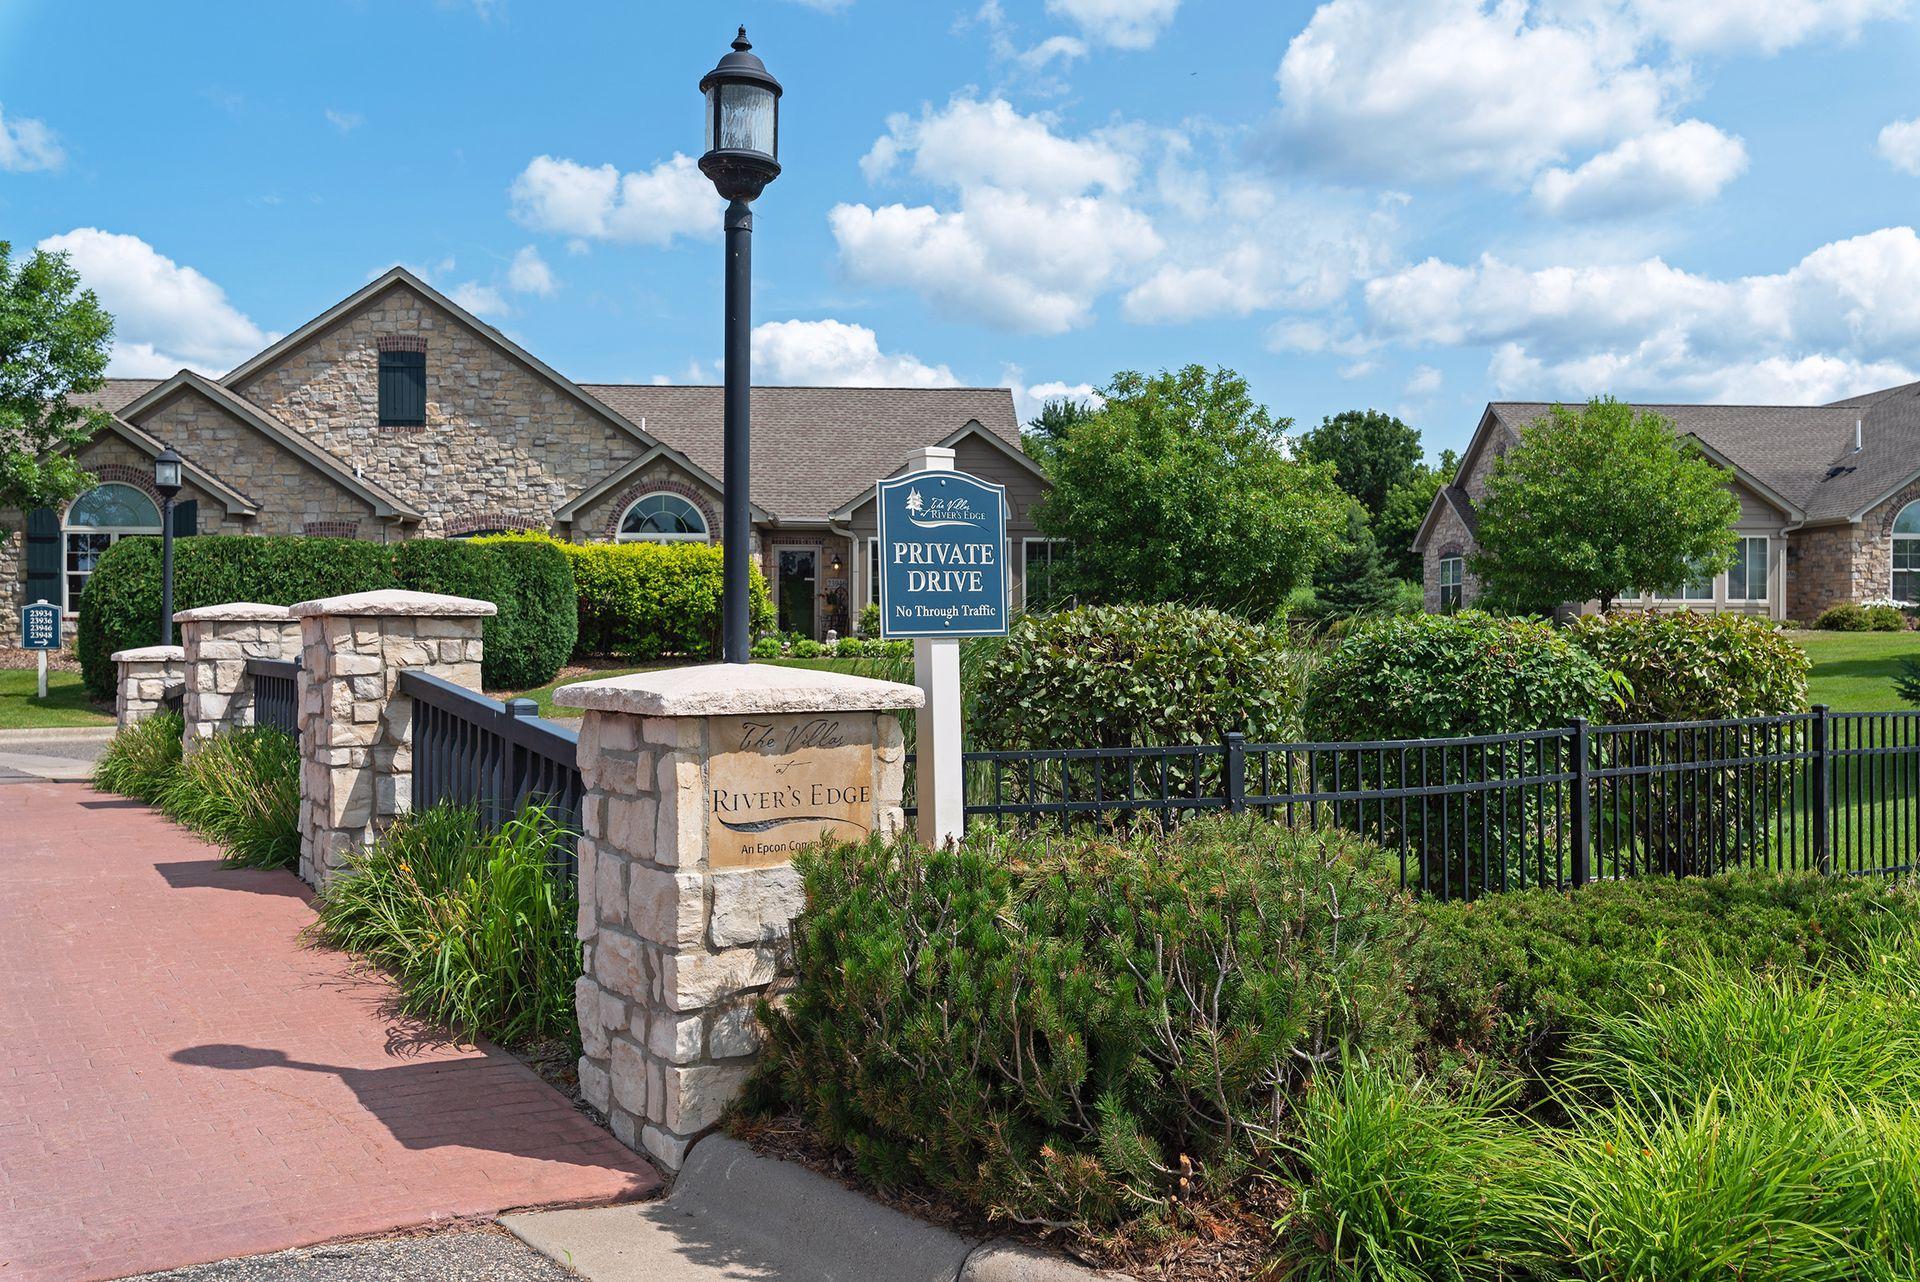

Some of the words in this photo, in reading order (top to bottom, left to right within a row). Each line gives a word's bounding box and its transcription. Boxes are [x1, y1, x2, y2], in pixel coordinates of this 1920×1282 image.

[930, 496, 944, 510] The
[931, 509, 961, 519] RIVER'S
[964, 510, 986, 520] EDGE
[893, 542, 995, 565] PRIVATE
[907, 570, 984, 592] DRIVE
[30, 609, 53, 617] 23934
[895, 605, 912, 617] No
[915, 605, 959, 619] Through
[961, 604, 996, 617] Traffic
[30, 631, 53, 639] 23948
[739, 721, 775, 752] The
[784, 718, 846, 754] Villas
[773, 759, 813, 775] at
[712, 785, 801, 814] RIVER'S
[811, 782, 870, 807] EDGE
[741, 844, 754, 855] An
[757, 841, 787, 856] Epcon
